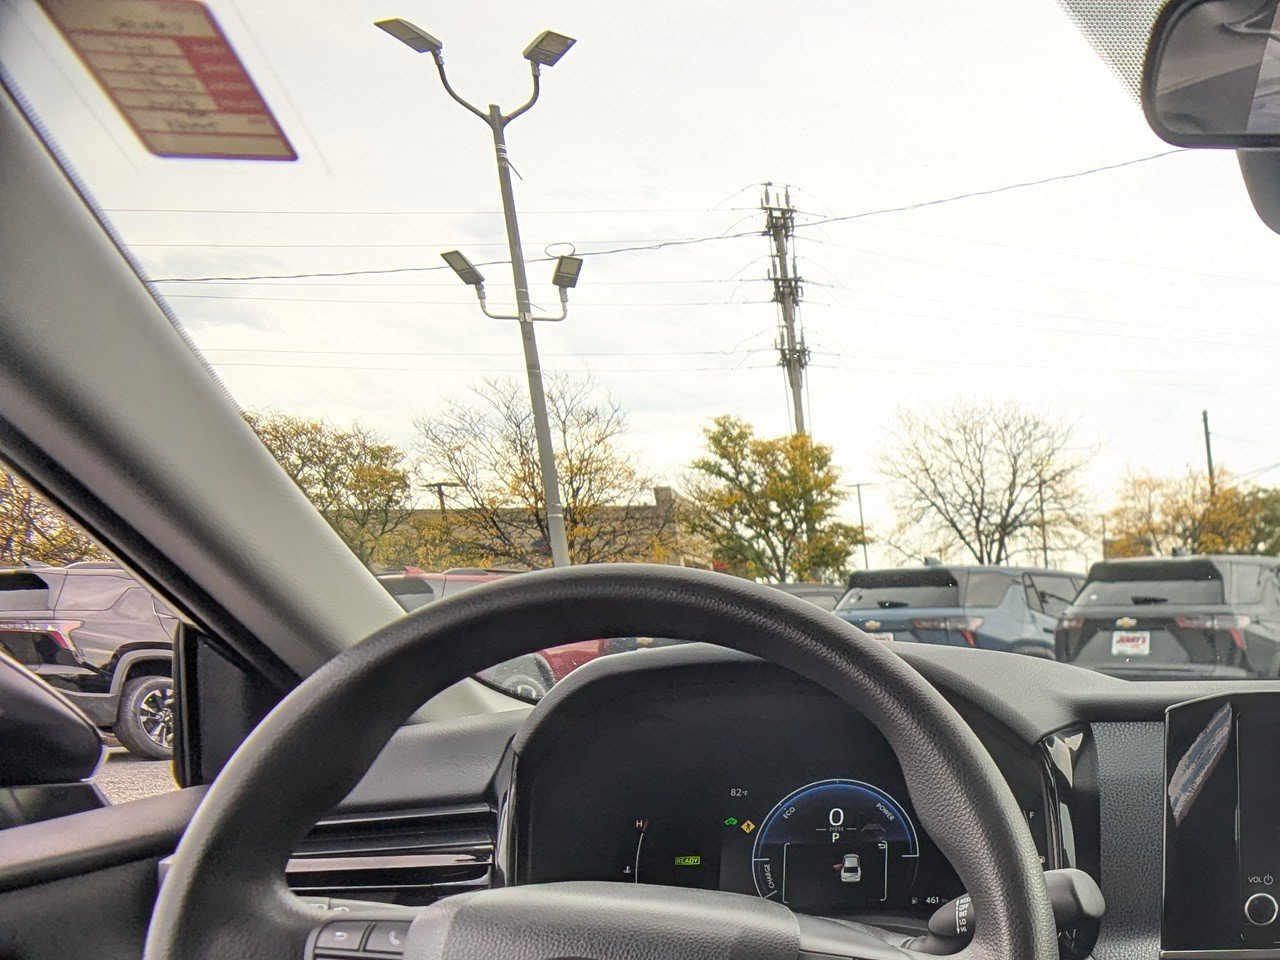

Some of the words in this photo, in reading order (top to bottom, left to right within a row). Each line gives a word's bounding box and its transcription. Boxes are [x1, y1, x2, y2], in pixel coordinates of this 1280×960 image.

[783, 806, 796, 820] ECO
[829, 808, 844, 826] 0
[876, 802, 896, 822] POWER
[832, 832, 840, 843] P
[676, 857, 699, 865] READY
[763, 864, 776, 889] CHARGE
[925, 896, 939, 904] 461
[959, 918, 967, 926] LO
